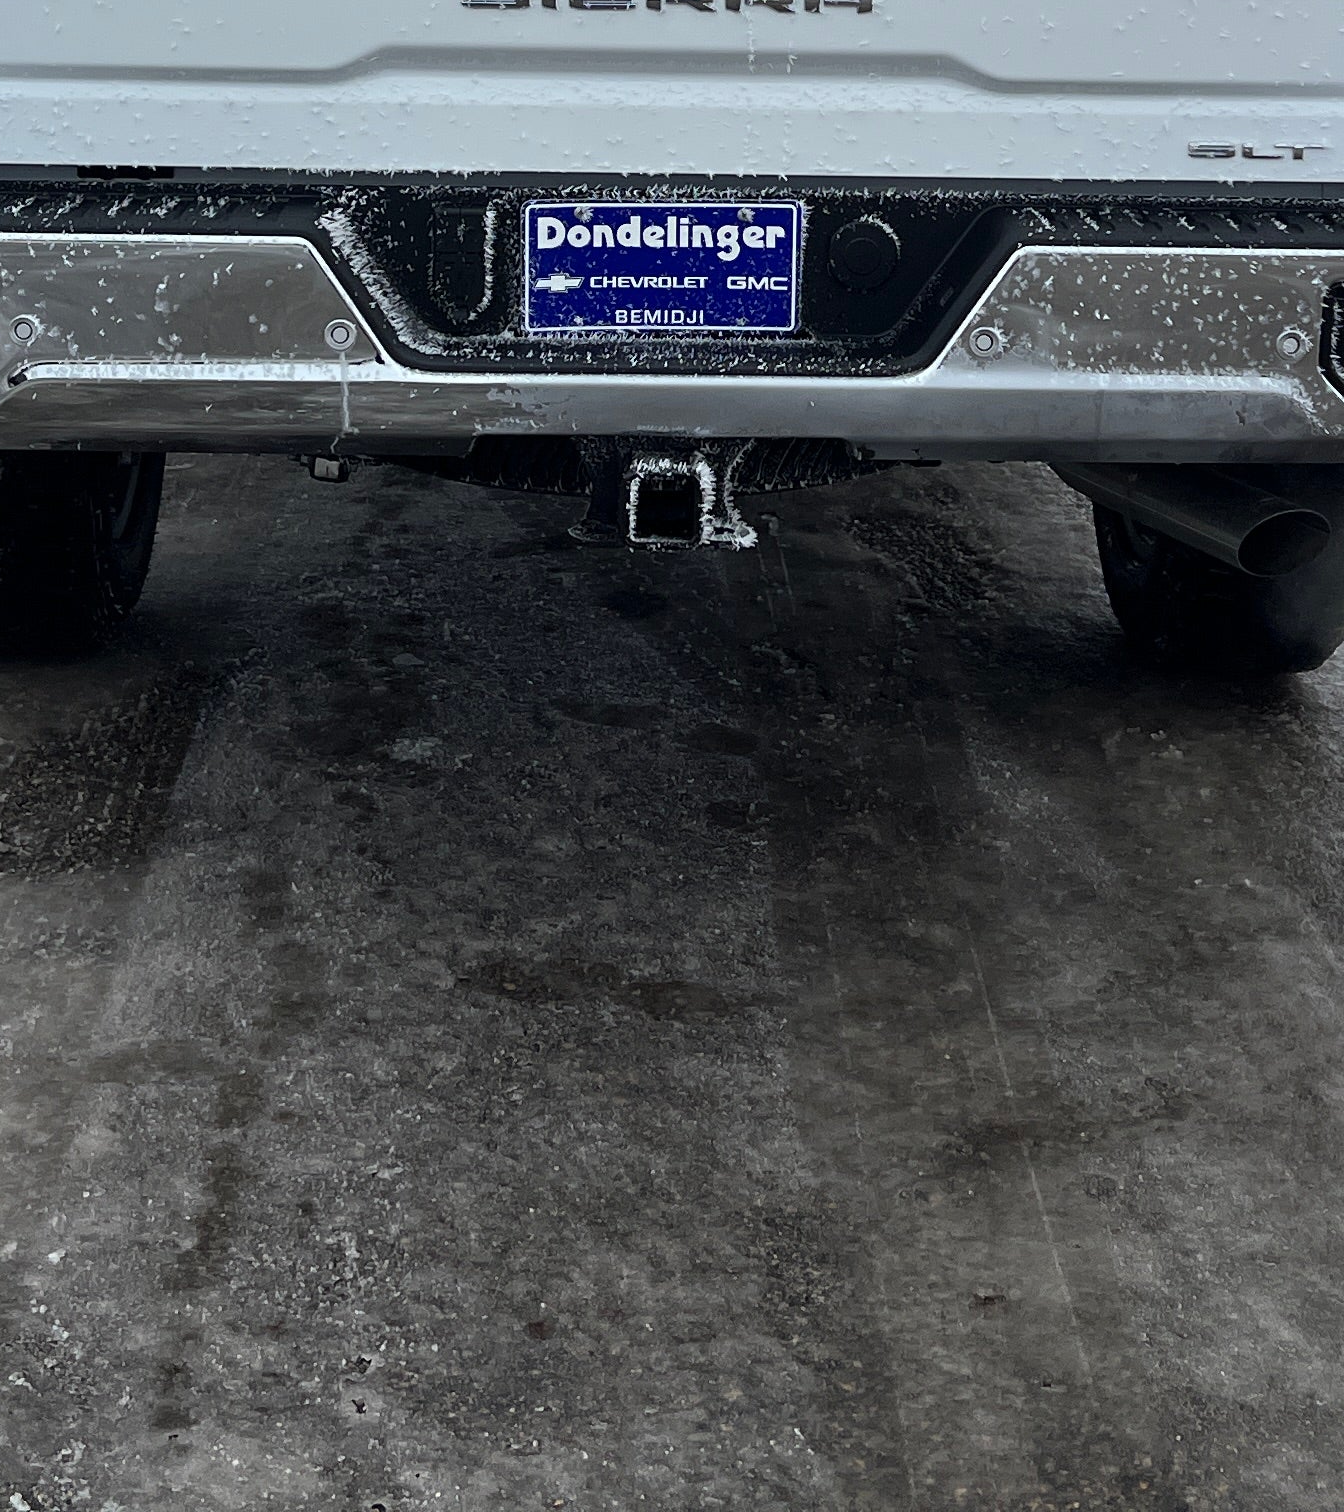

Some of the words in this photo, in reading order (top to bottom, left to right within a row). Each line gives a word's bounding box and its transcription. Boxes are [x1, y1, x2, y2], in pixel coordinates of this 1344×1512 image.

[1187, 141, 1326, 160] SLT
[536, 215, 786, 262] Dondelinger
[589, 276, 709, 289] CHEVROLET
[726, 276, 788, 291] GMC
[615, 309, 704, 325] BEMIDJI
